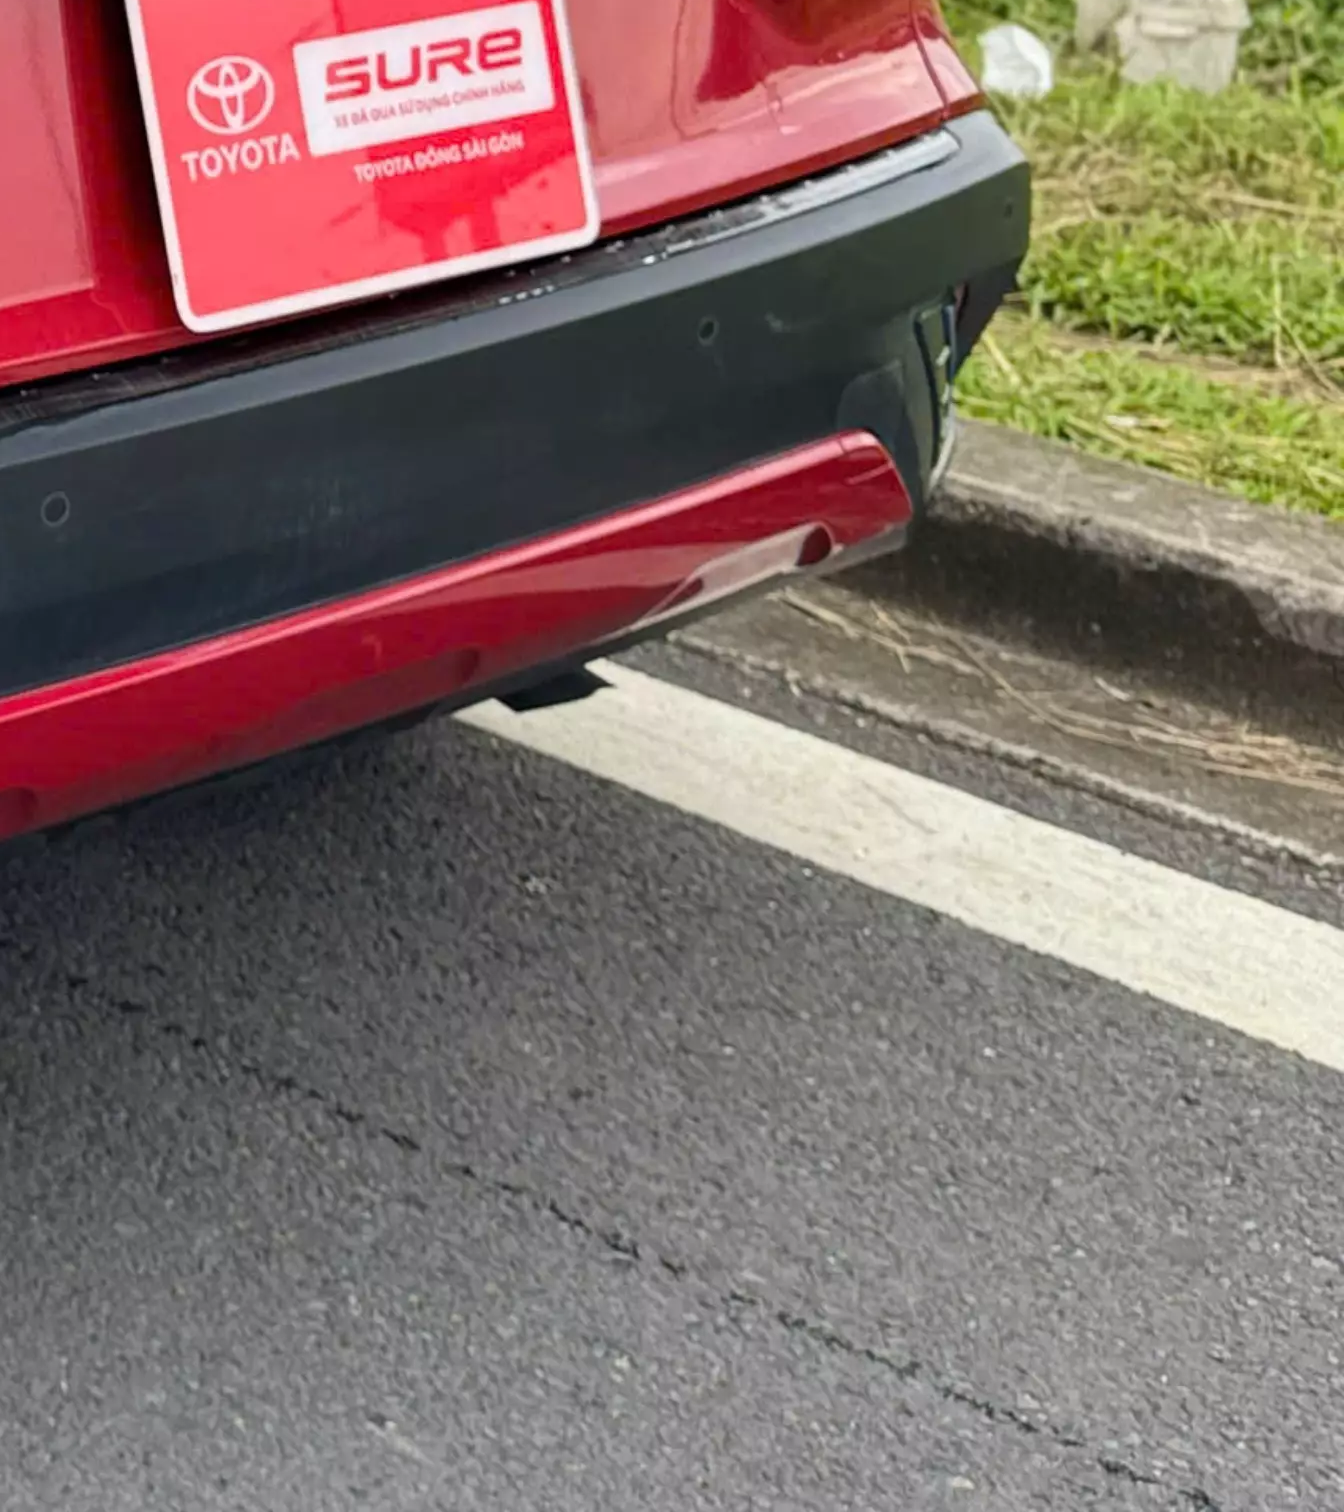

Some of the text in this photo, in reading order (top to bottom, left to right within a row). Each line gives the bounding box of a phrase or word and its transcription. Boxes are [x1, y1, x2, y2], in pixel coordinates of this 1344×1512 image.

[370, 103, 396, 122] QUA
[180, 132, 302, 183] TOYOTA
[353, 155, 413, 184] TOYOTA
[413, 144, 462, 171] ĐÔNG
[487, 130, 525, 154] GÒN
